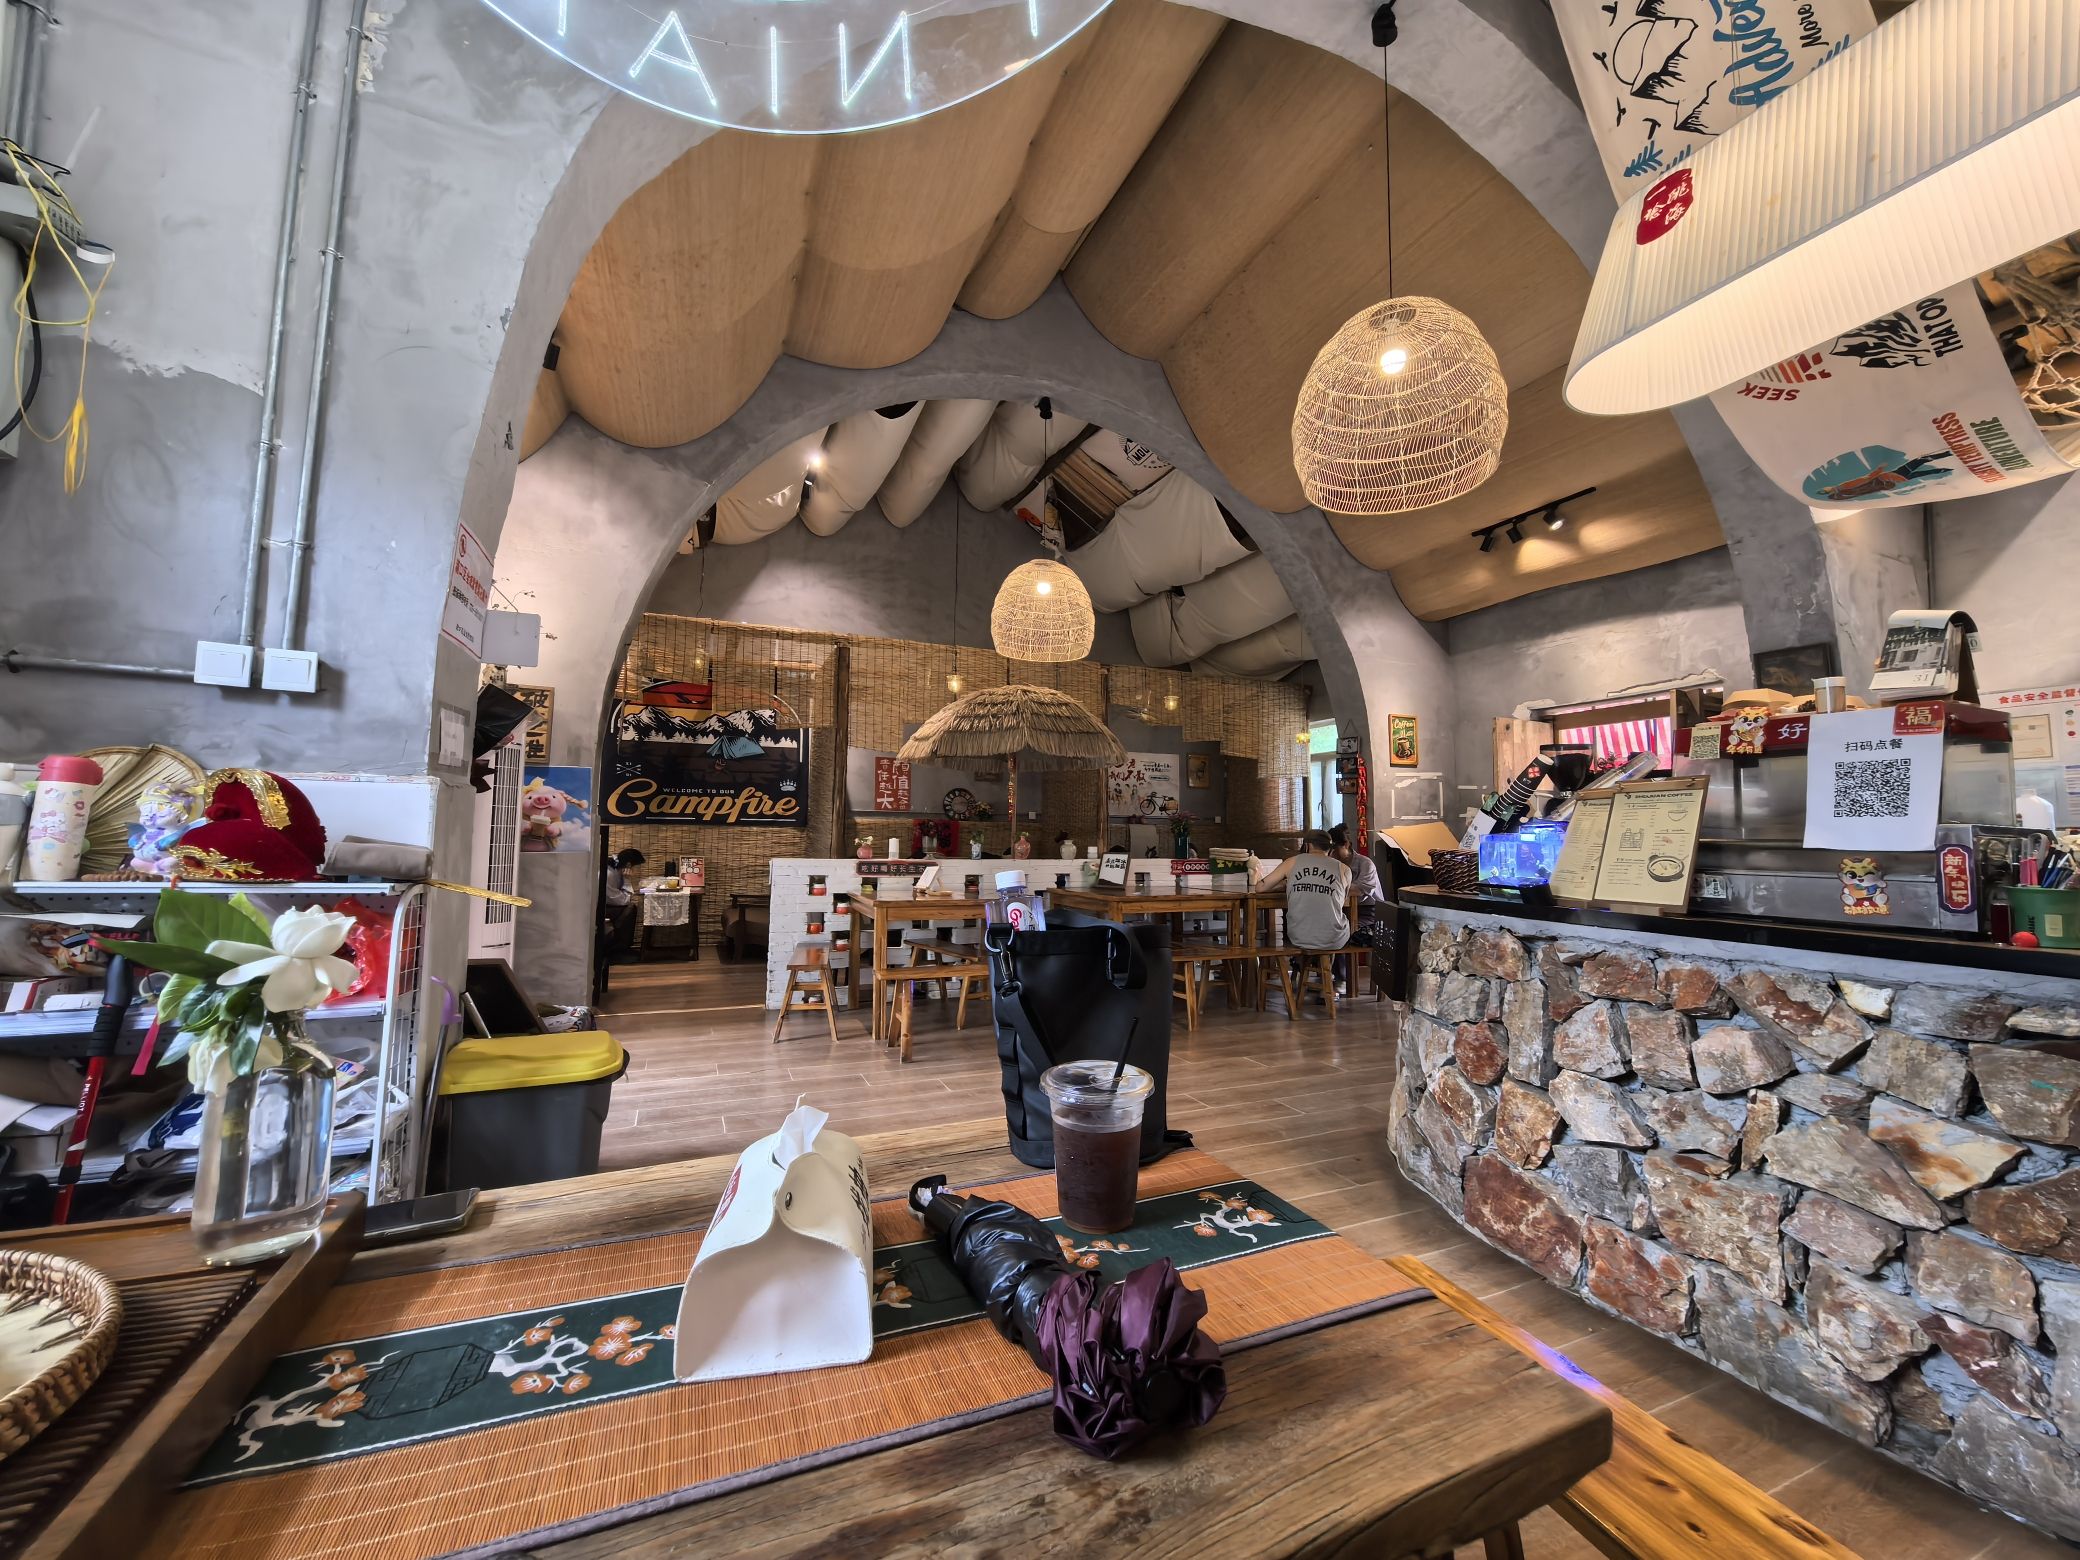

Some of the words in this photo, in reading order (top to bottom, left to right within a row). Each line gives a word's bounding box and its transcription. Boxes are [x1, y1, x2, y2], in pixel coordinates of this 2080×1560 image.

[1923, 318, 1964, 358] THAT
[1737, 381, 1801, 402] SEEK
[1931, 411, 1985, 465] TEMPTRESS
[1970, 416, 2034, 472] ADVENTURE
[1998, 687, 2080, 705] 食品安全监督
[1777, 723, 1809, 740] 好
[1844, 738, 1904, 753] 扫码点餐
[606, 777, 800, 824] Campfire
[662, 787, 703, 795] WELCOME
[1295, 867, 1336, 886] URBAN
[1292, 882, 1336, 897] TERRITORY
